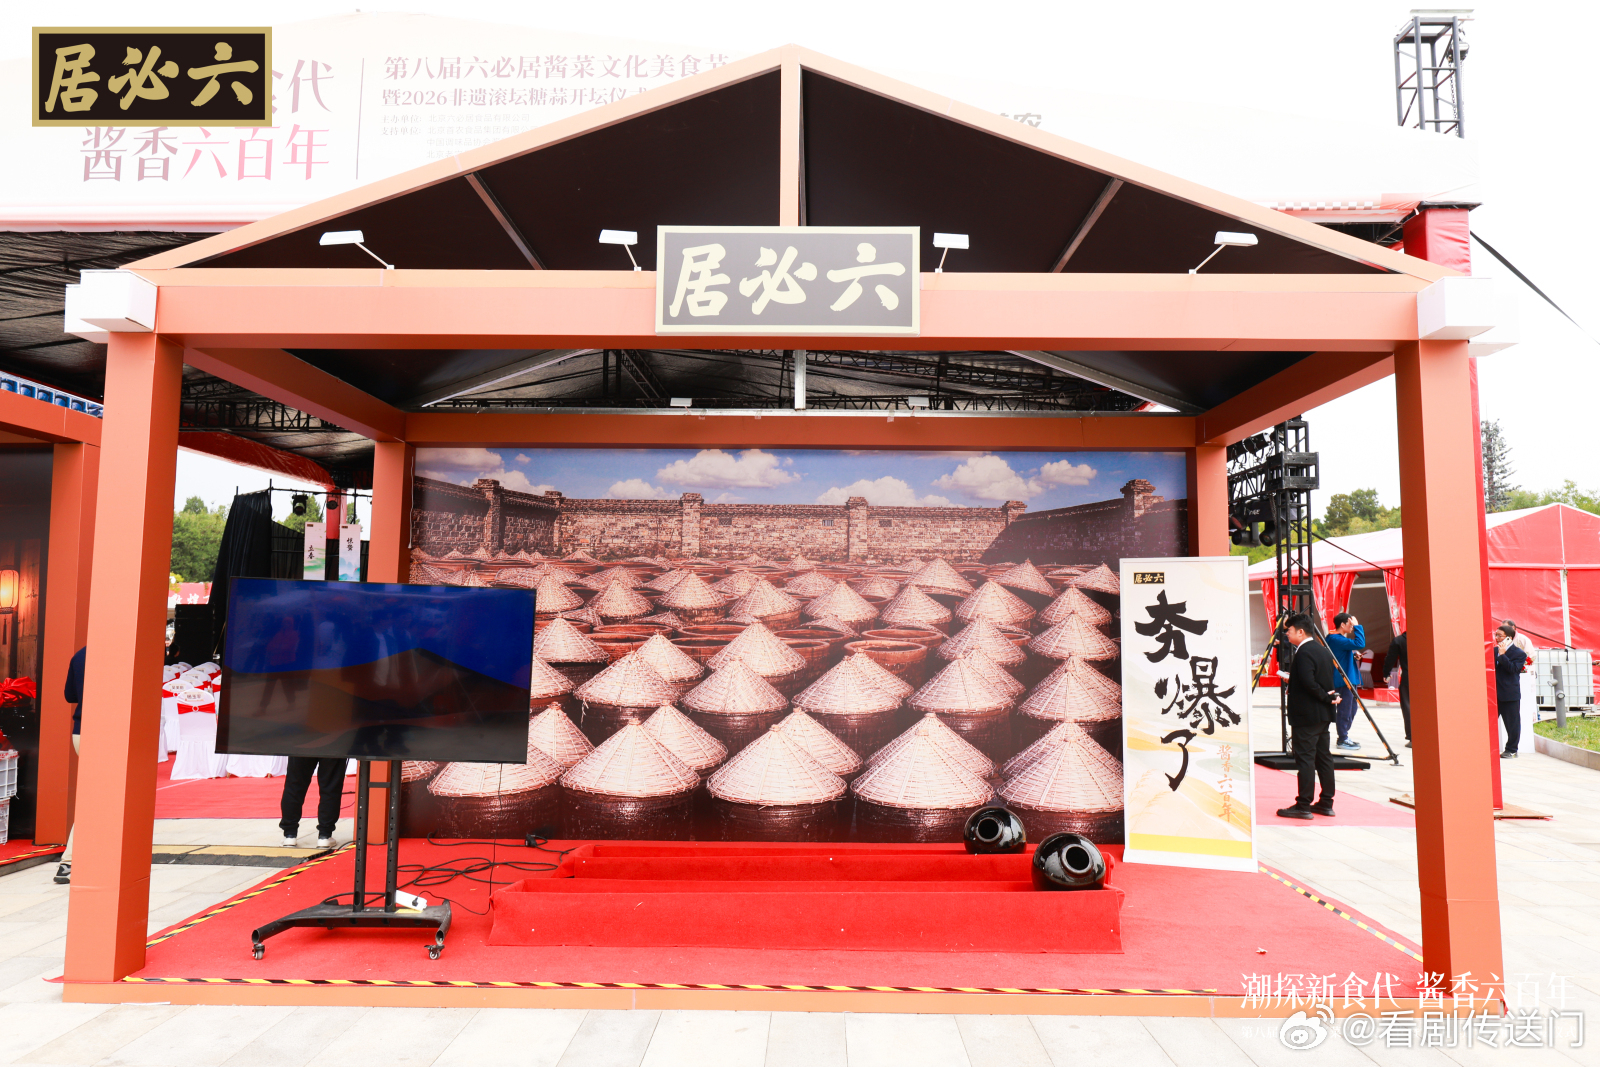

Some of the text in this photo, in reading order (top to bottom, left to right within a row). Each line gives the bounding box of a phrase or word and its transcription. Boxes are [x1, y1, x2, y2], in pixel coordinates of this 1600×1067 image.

[80, 123, 330, 182] 酱香六百年
[1134, 589, 1241, 791] 夯爆了
[1217, 744, 1236, 822] 酱香六百年
